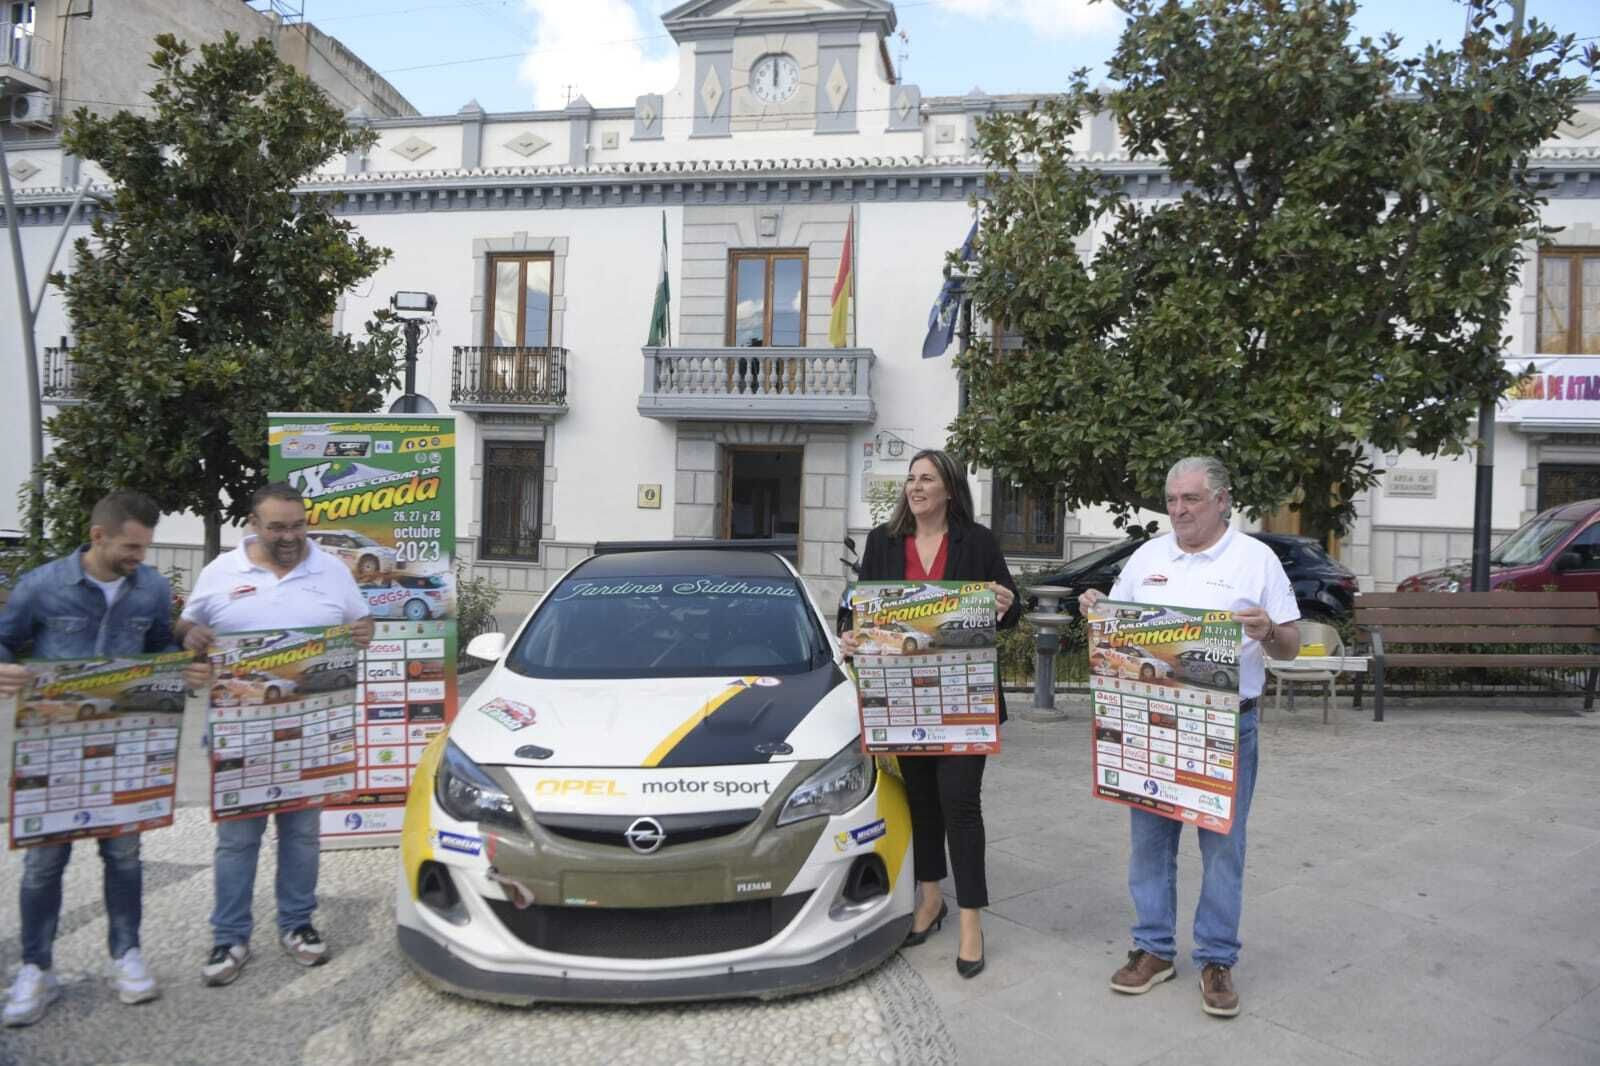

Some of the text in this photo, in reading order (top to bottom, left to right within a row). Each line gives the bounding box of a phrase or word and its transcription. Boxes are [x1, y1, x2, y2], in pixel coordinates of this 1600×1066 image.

[422, 466, 441, 476] DE
[409, 512, 420, 522] 27
[422, 513, 429, 523] y
[394, 525, 441, 539] octubre
[395, 541, 440, 562] 2023
[554, 582, 664, 600] Jardines
[873, 595, 960, 626] Granada
[962, 616, 990, 629] 2023
[1108, 623, 1202, 648] Granada
[1204, 637, 1236, 648] octubre
[1204, 647, 1236, 664] 2023
[535, 777, 772, 798] OPEL motor sport
[856, 821, 886, 842] MICHELIN
